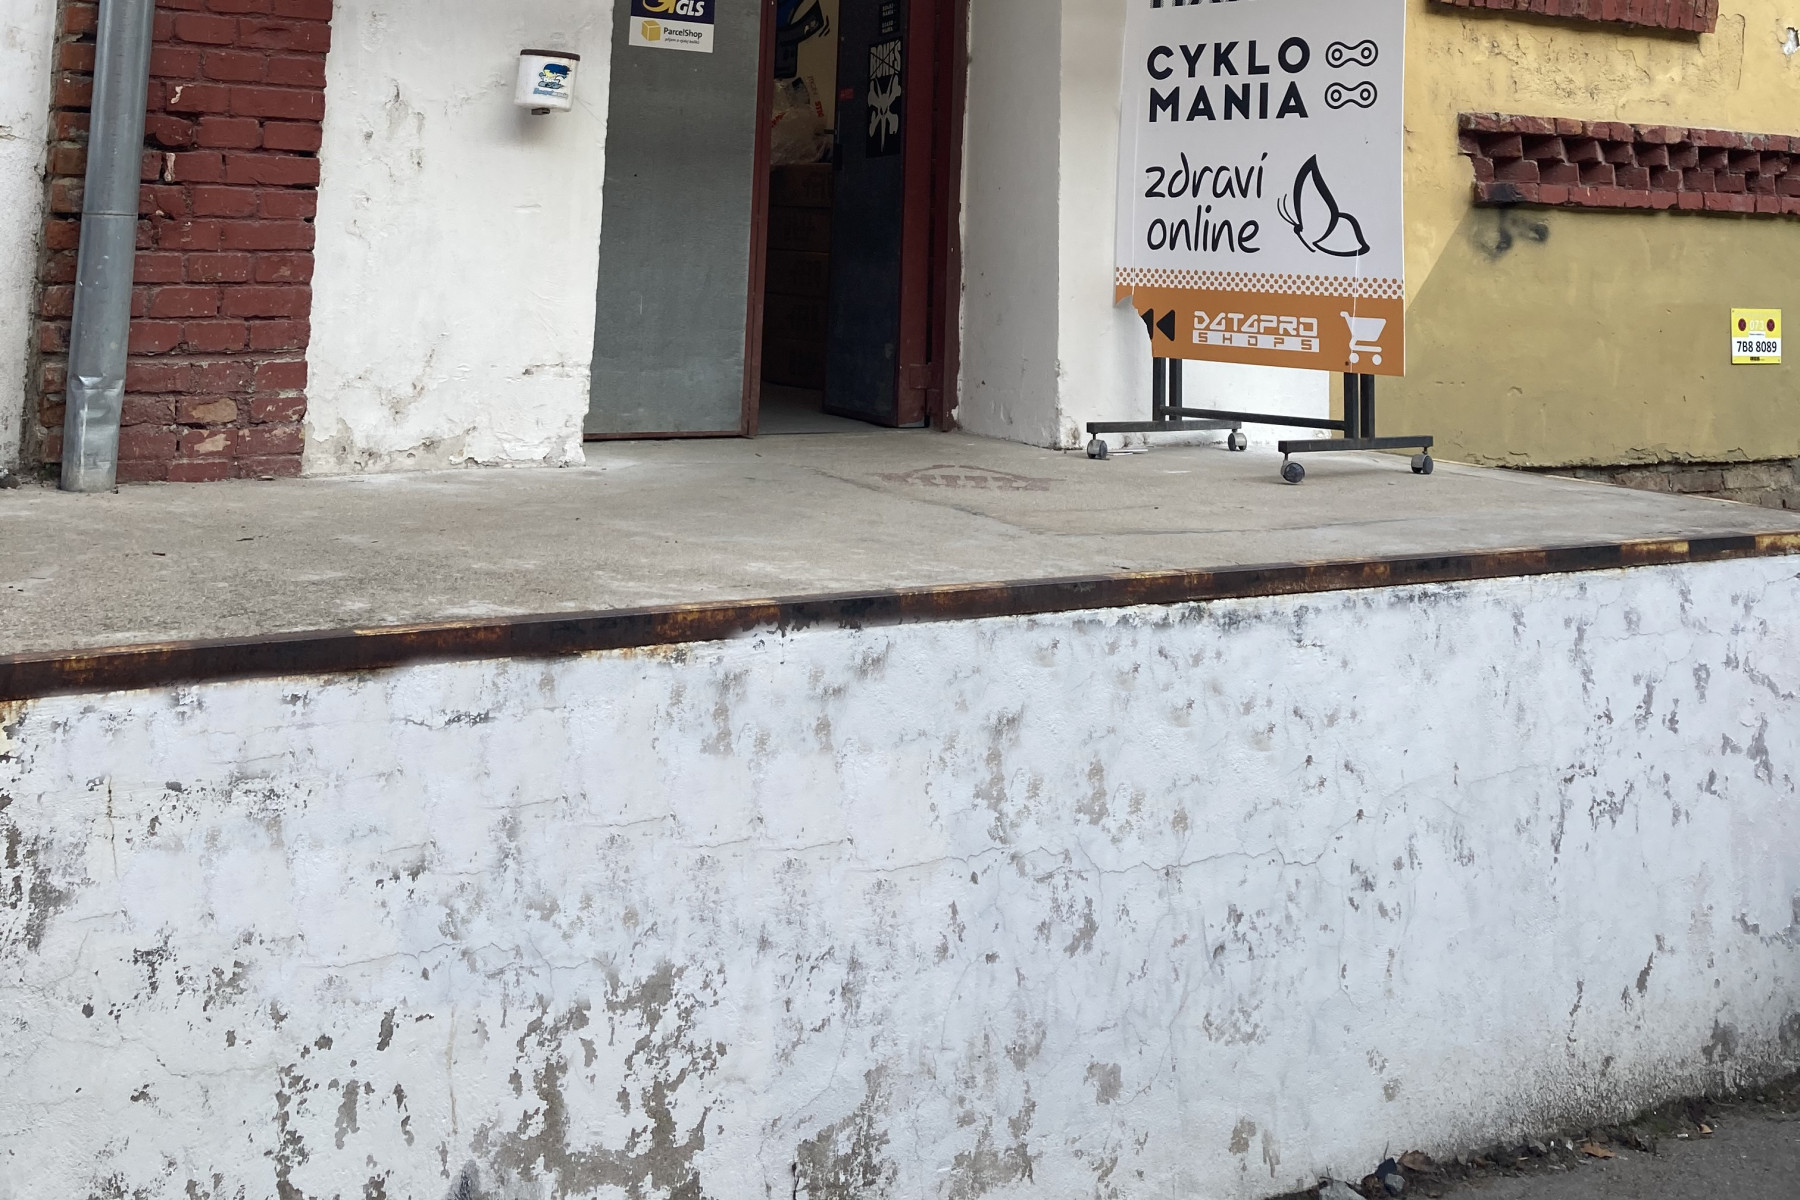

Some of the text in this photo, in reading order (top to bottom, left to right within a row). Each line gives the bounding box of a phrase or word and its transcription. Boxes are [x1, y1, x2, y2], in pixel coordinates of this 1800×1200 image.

[675, 0, 705, 17] GLS
[663, 27, 703, 40] ParcelShop
[870, 40, 901, 79] BONES
[1147, 36, 1310, 81] CYKLO
[1149, 81, 1309, 123] MANIA
[1145, 152, 1268, 199] zdraví
[1147, 204, 1261, 254] online
[1193, 310, 1318, 337] DATAPRO
[1197, 331, 1313, 351] SHOPS
[1755, 341, 1777, 353] 8089
